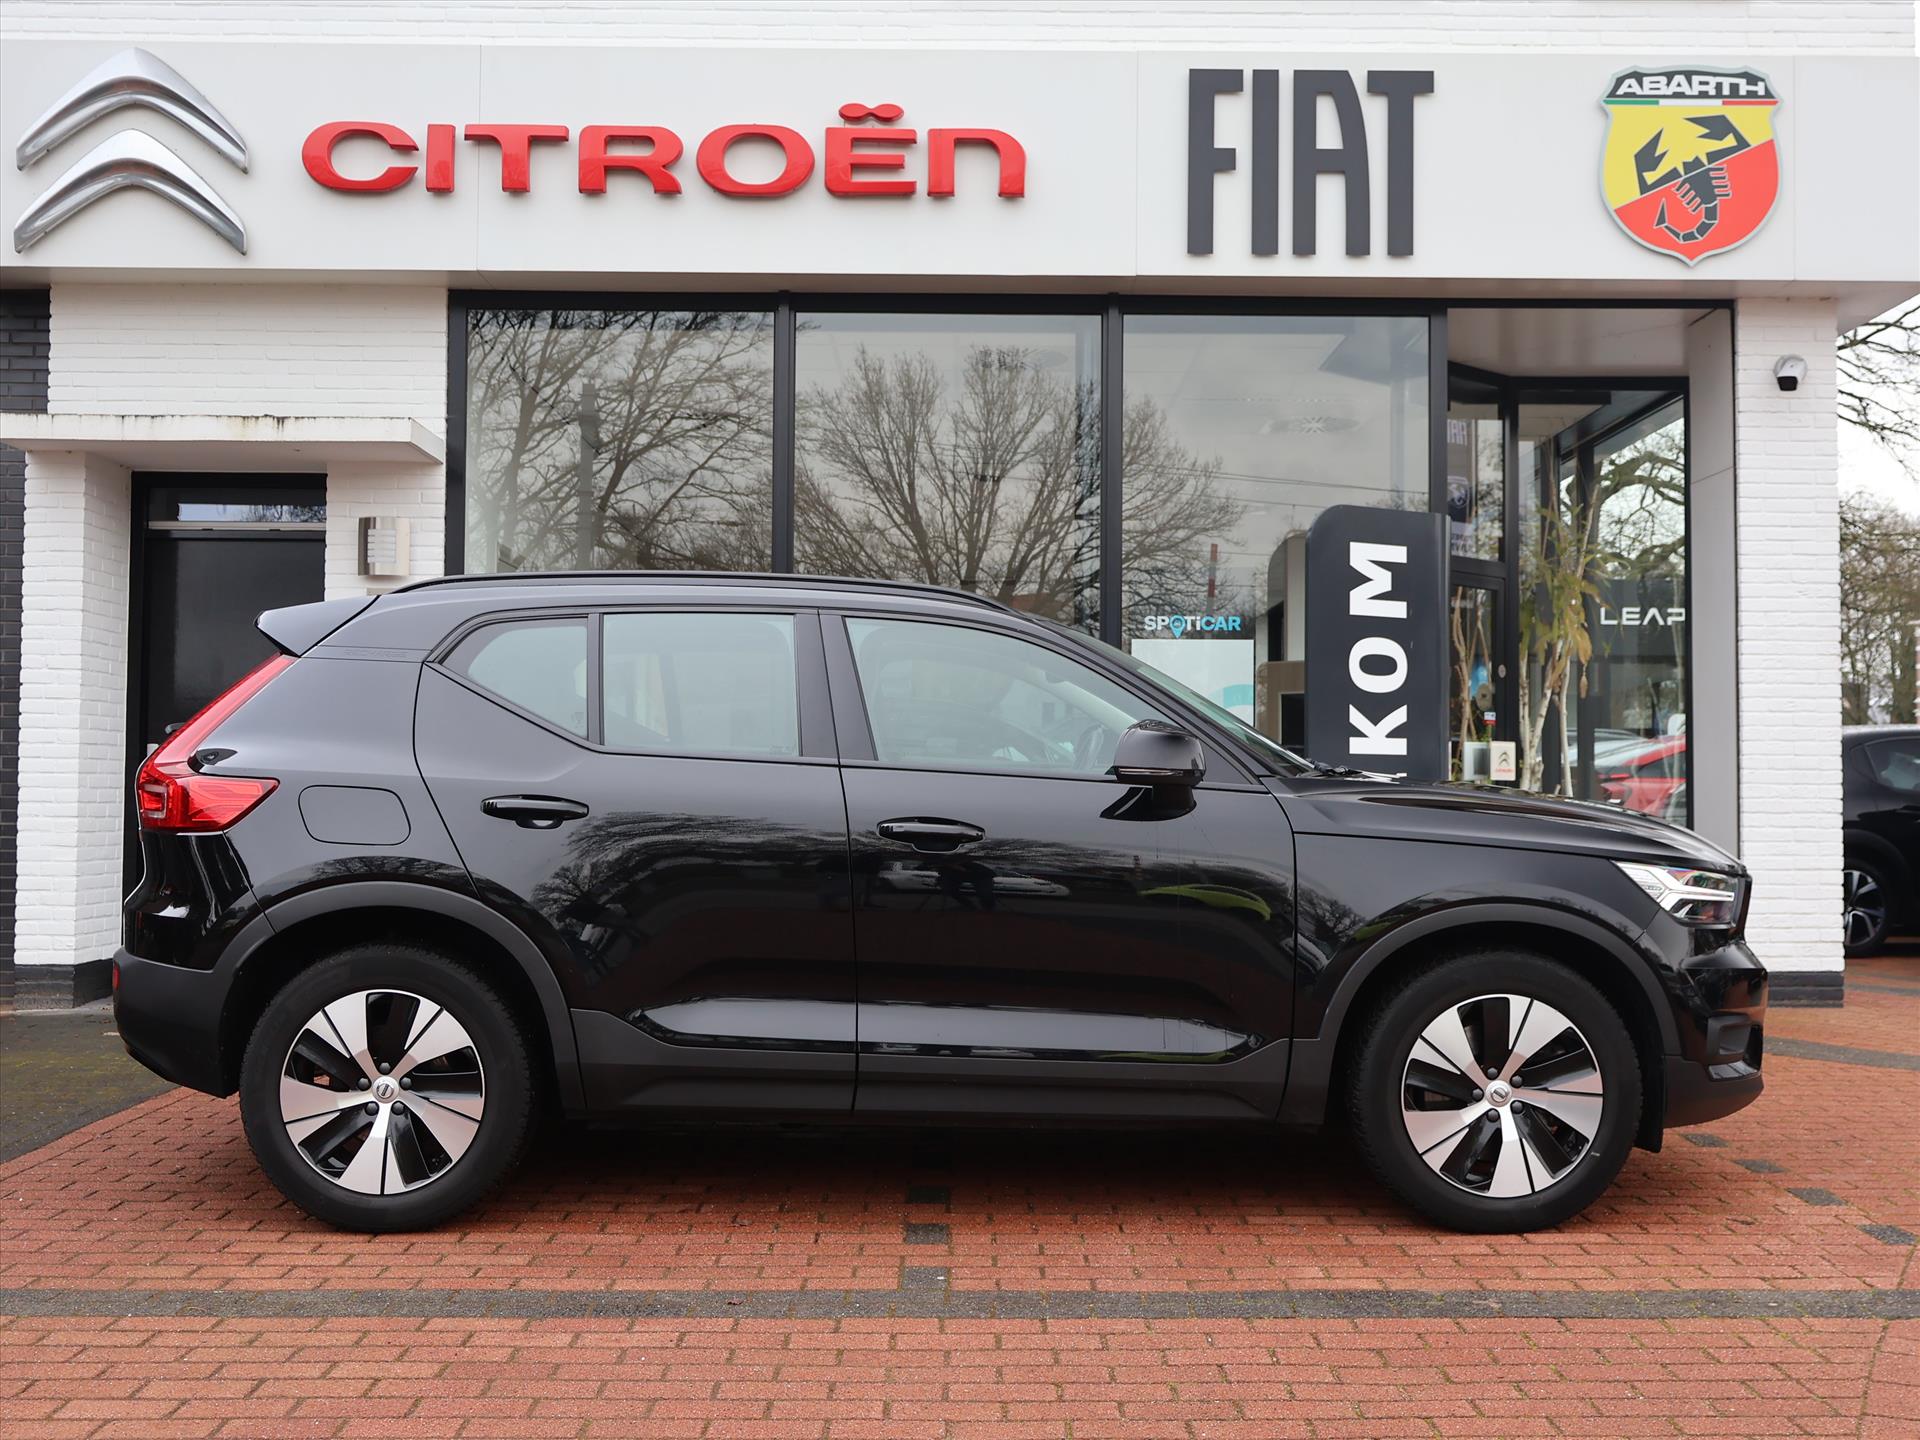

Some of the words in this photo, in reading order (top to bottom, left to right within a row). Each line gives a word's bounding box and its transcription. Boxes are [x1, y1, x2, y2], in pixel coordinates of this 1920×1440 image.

[1615, 74, 1765, 96] ABARTH
[301, 102, 1027, 199] CITROËN
[1187, 68, 1435, 257] FIAT
[1349, 541, 1408, 778] KOM
[1600, 607, 1686, 626] LEAP
